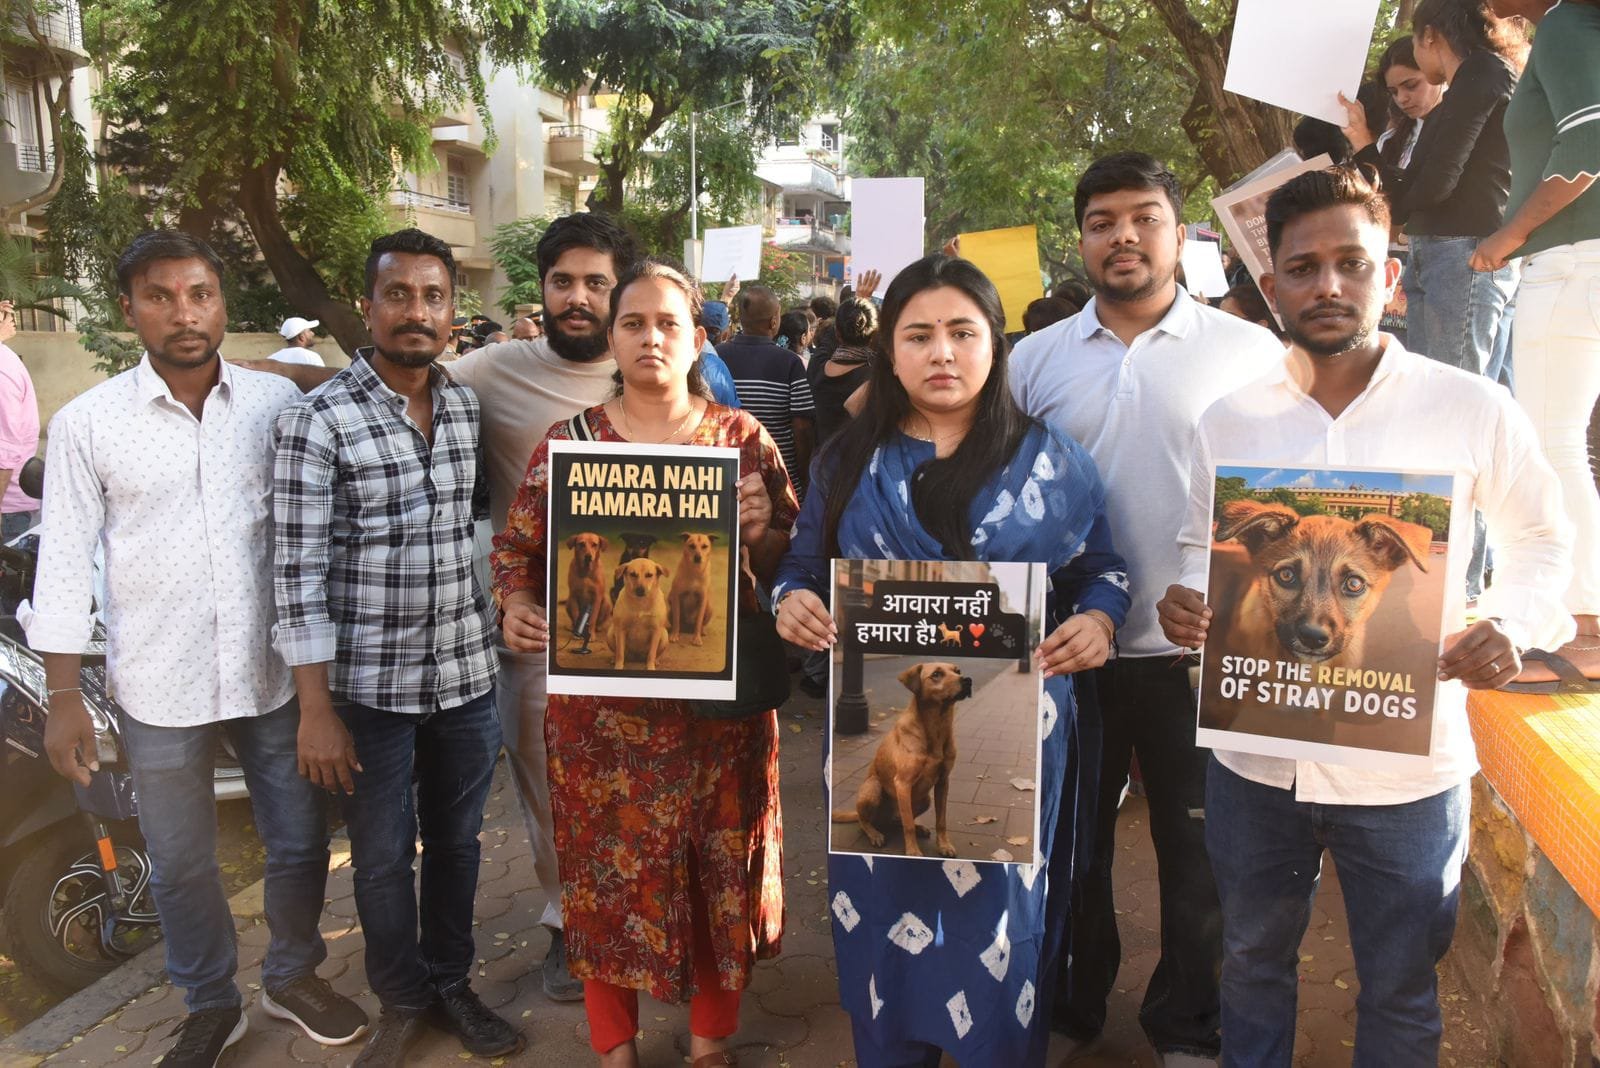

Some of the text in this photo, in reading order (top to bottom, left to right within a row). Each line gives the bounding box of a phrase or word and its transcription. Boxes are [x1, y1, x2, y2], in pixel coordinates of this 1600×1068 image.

[567, 462, 723, 491] AWARA NAHI
[571, 491, 719, 519] HAMARA HAI
[882, 590, 991, 618] आवारा नहीं
[856, 618, 937, 644] हमारा है!
[1221, 655, 1415, 693] STOP THE REMOVAL
[1220, 676, 1417, 720] OF STRAY DOGS
